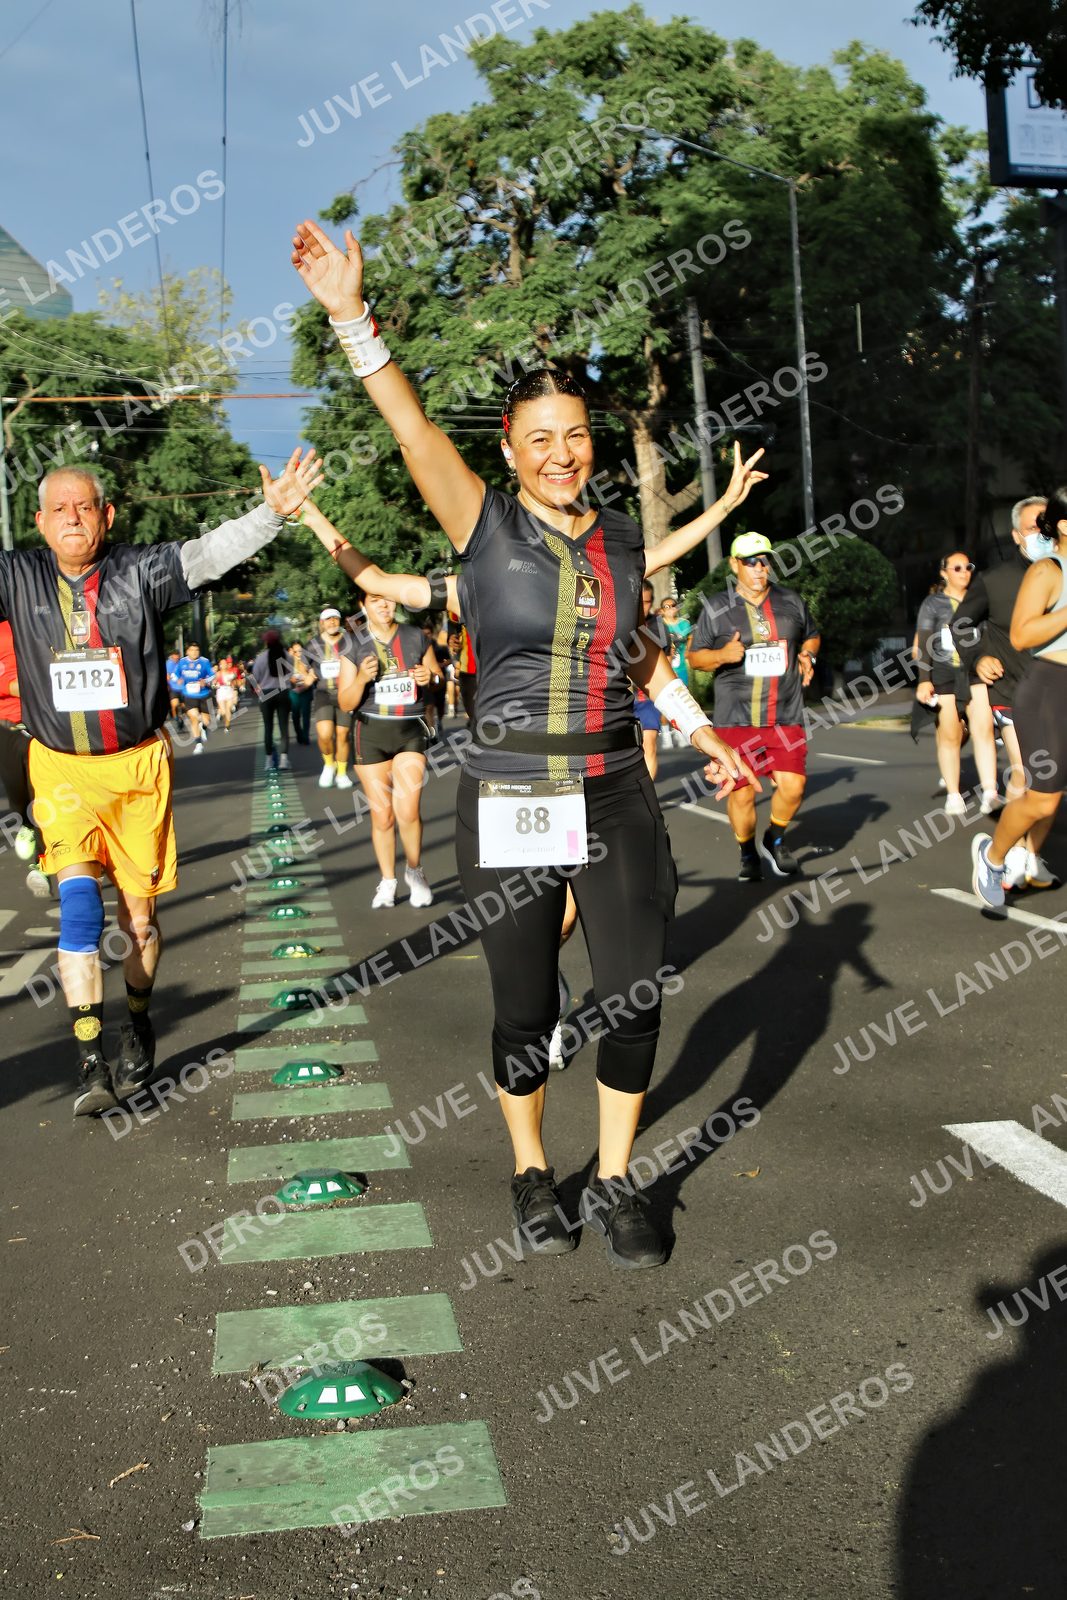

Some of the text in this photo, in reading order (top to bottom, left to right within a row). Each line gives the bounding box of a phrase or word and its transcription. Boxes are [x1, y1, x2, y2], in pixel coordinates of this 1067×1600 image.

[750, 652, 781, 663] 11264
[54, 668, 115, 690] 12182
[378, 681, 412, 693] 11508
[515, 806, 551, 835] 88
